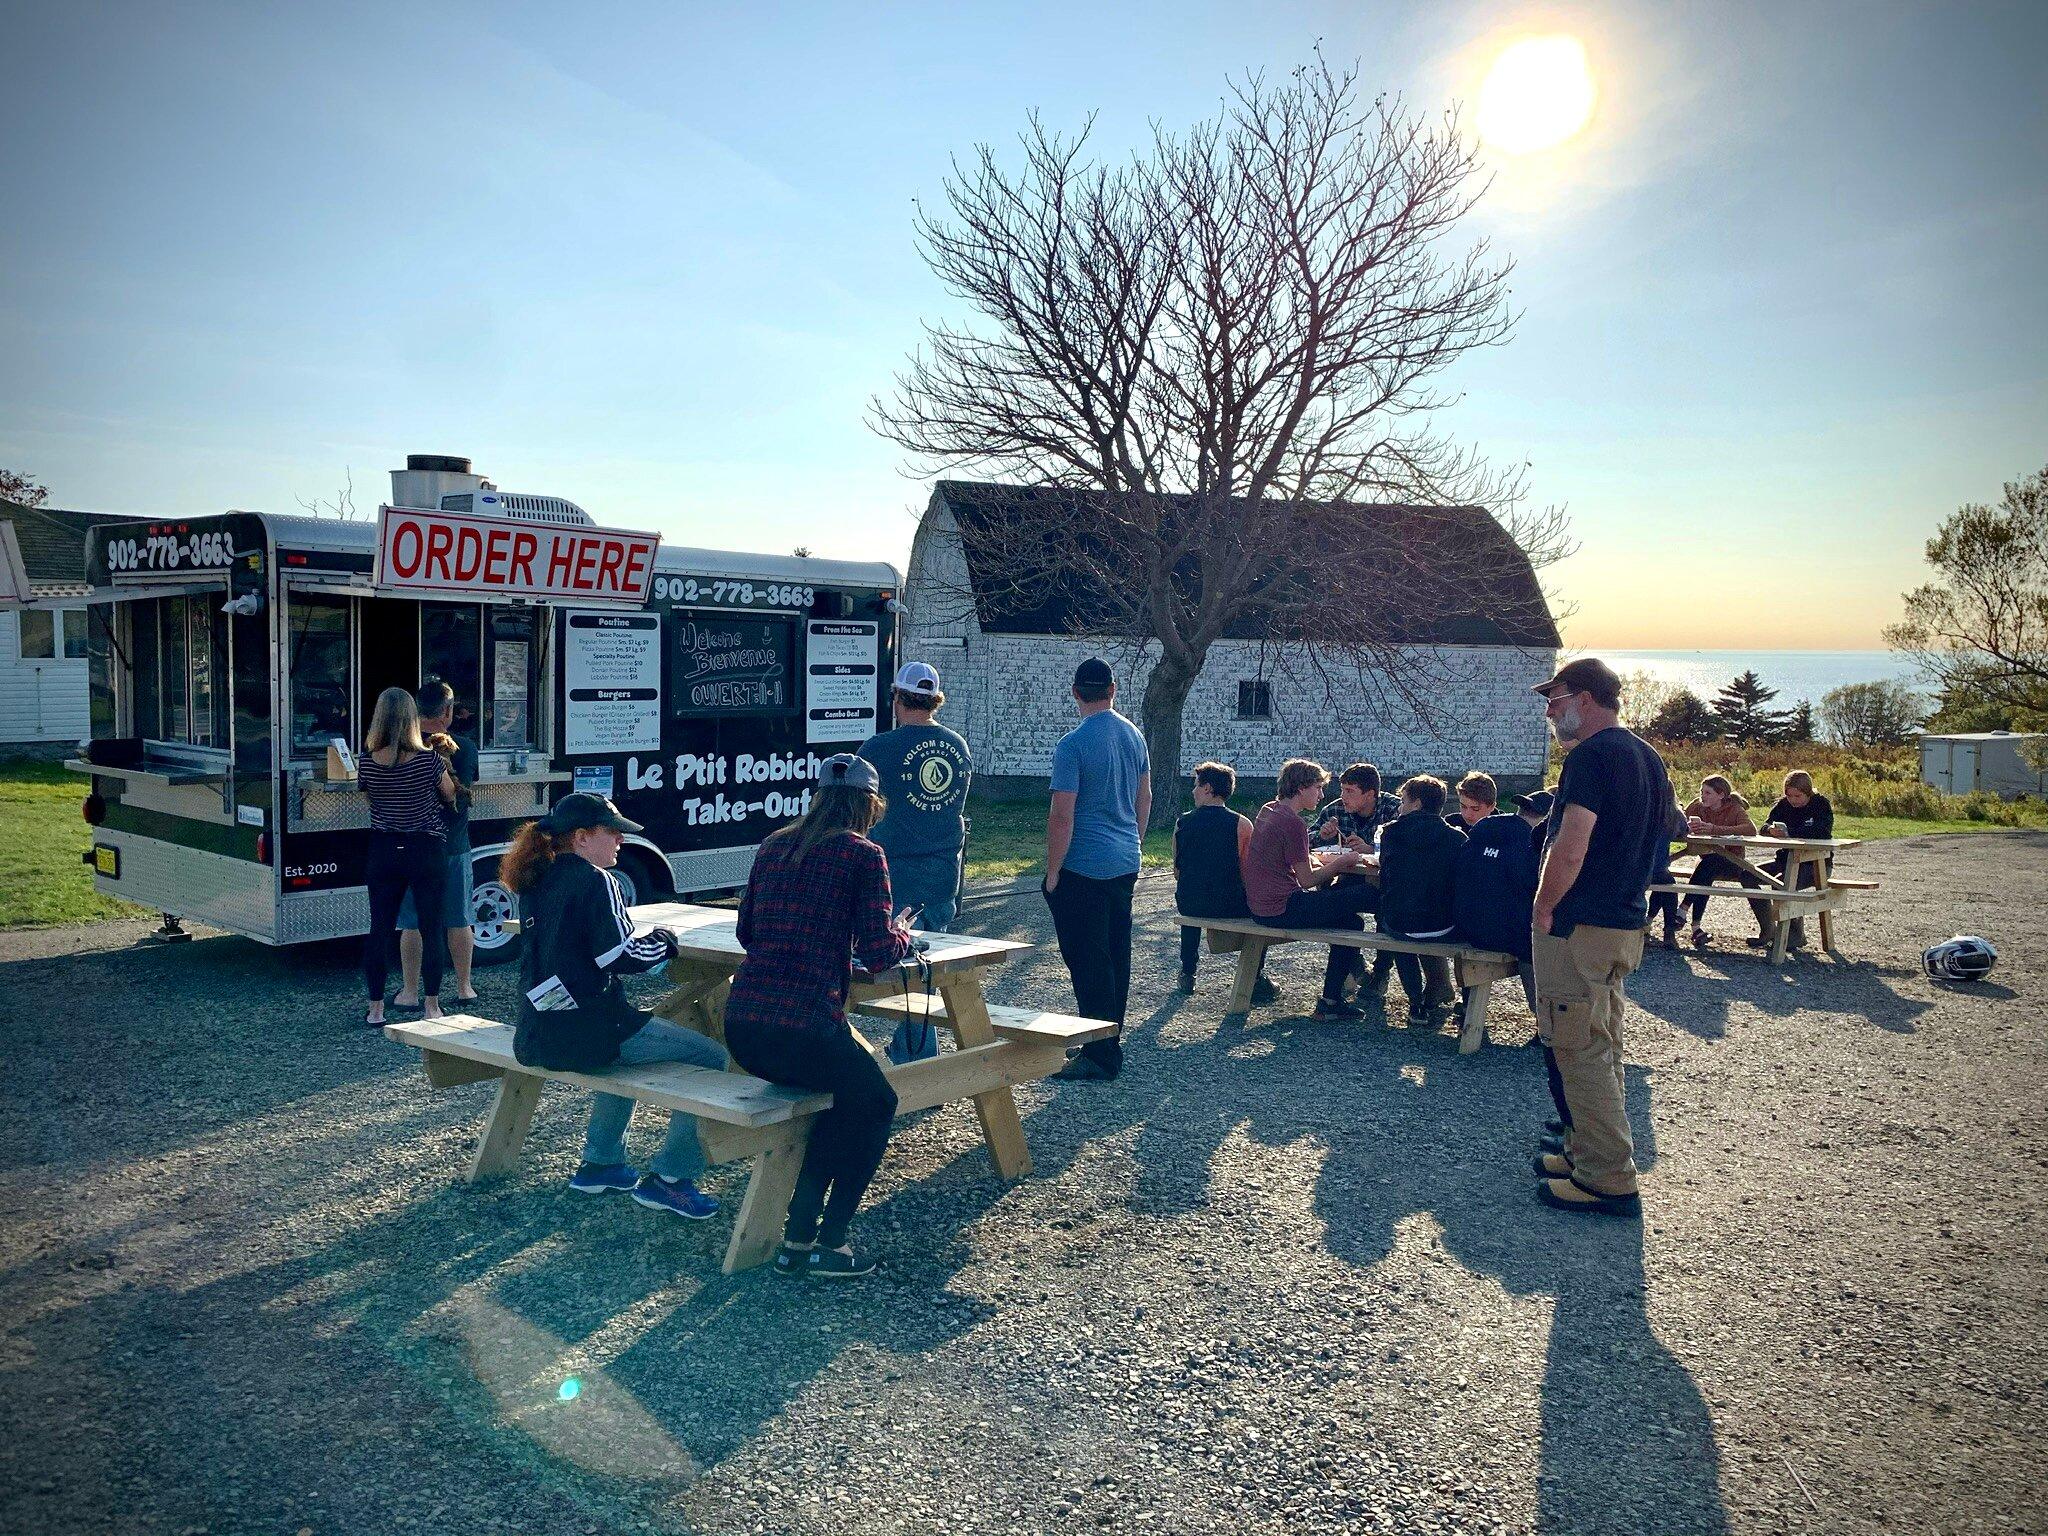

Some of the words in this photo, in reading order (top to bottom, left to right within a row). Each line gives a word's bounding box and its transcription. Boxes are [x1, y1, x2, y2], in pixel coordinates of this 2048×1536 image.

[108, 531, 235, 571] 902-778-3663
[392, 521, 538, 586] ORDER
[547, 536, 650, 592] HERE
[654, 577, 815, 608] 902-778-3663
[598, 617, 630, 626] Poutine
[824, 626, 840, 634] From
[852, 626, 862, 634] Sea
[683, 649, 776, 679] Bienvenue
[598, 690, 631, 701] Burgers
[825, 710, 845, 718] Combo
[846, 710, 860, 718] Deal
[903, 740, 936, 766] VOLCOM
[939, 740, 964, 765] STONE
[627, 757, 663, 791] Le
[675, 753, 727, 790] Ptit
[735, 752, 830, 783] Robich
[682, 788, 812, 826] Take-Out
[906, 792, 928, 811] TRUE
[1484, 846, 1499, 858] HH
[285, 866, 305, 877] Est.
[308, 863, 338, 876] 2020
